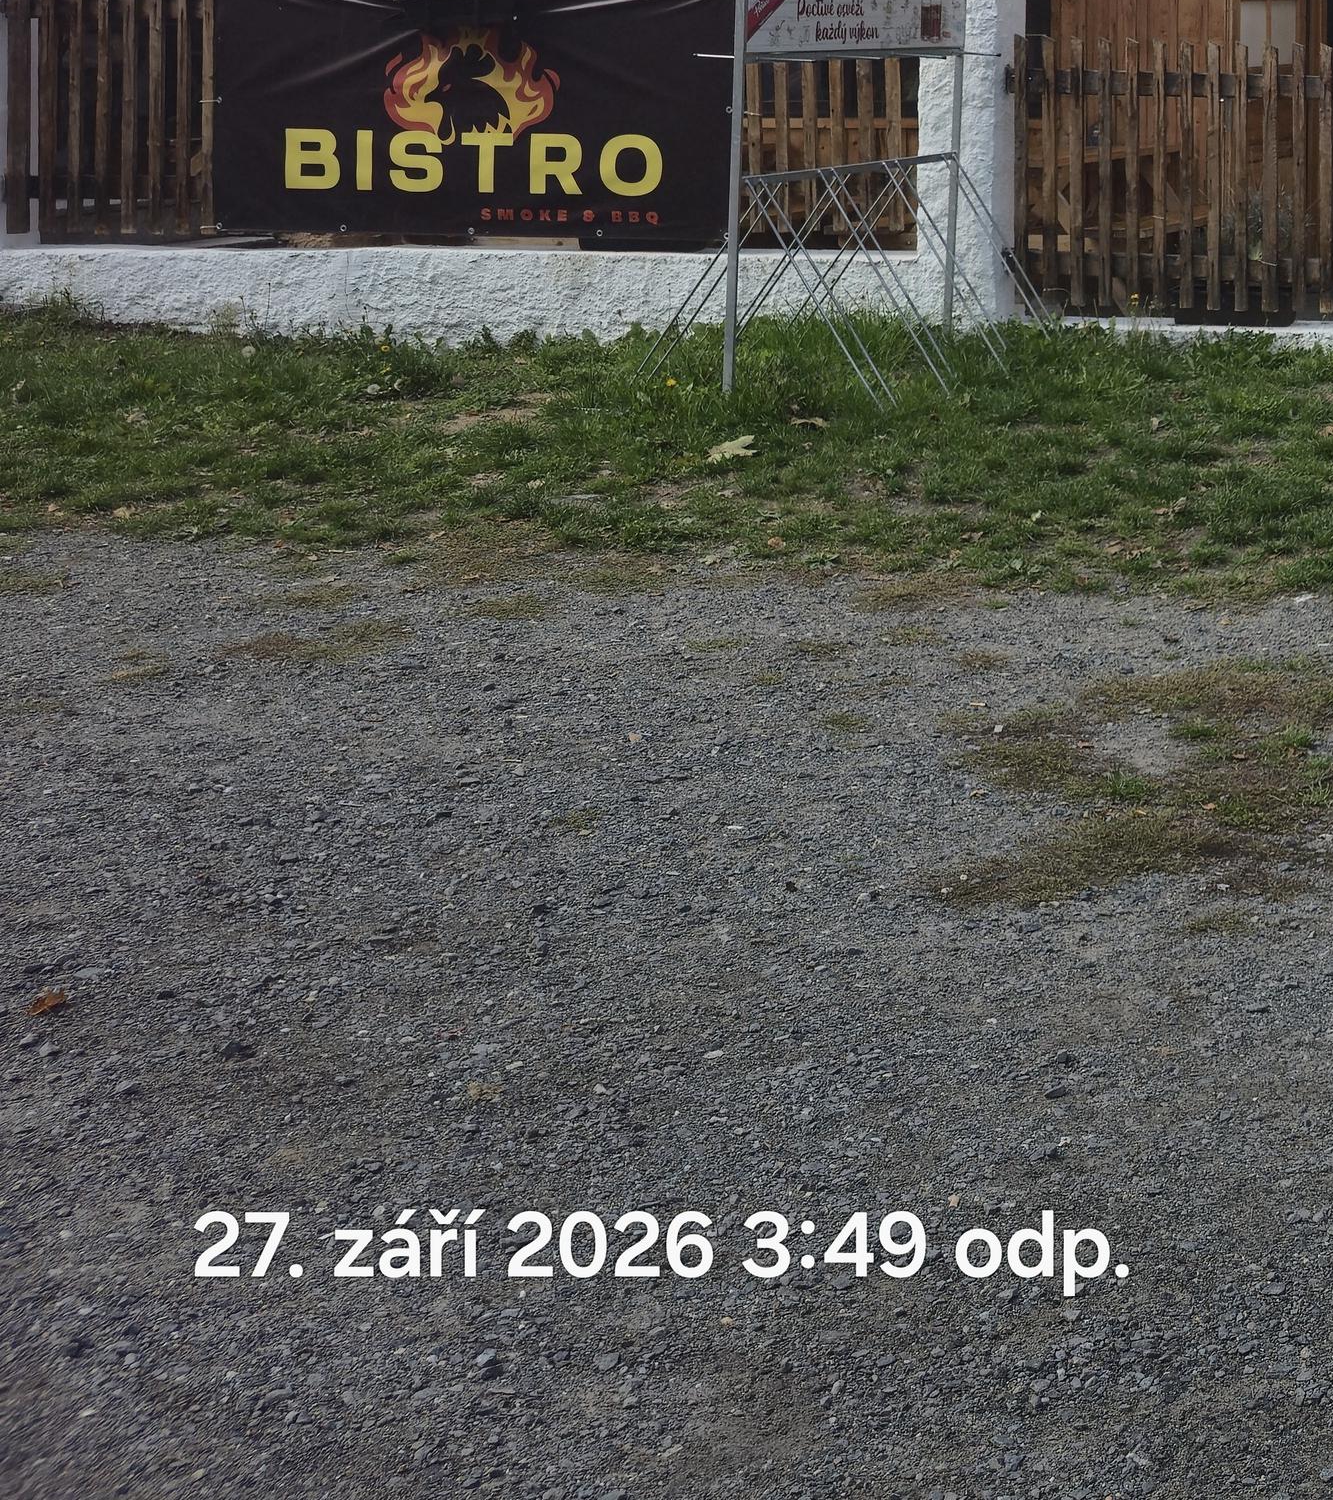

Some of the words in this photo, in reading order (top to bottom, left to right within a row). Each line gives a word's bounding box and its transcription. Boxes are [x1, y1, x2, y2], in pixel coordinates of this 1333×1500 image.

[815, 20, 847, 44] každý
[284, 128, 664, 197] BISTRO
[480, 208, 568, 222] SMOKE
[611, 210, 659, 225] BBQ
